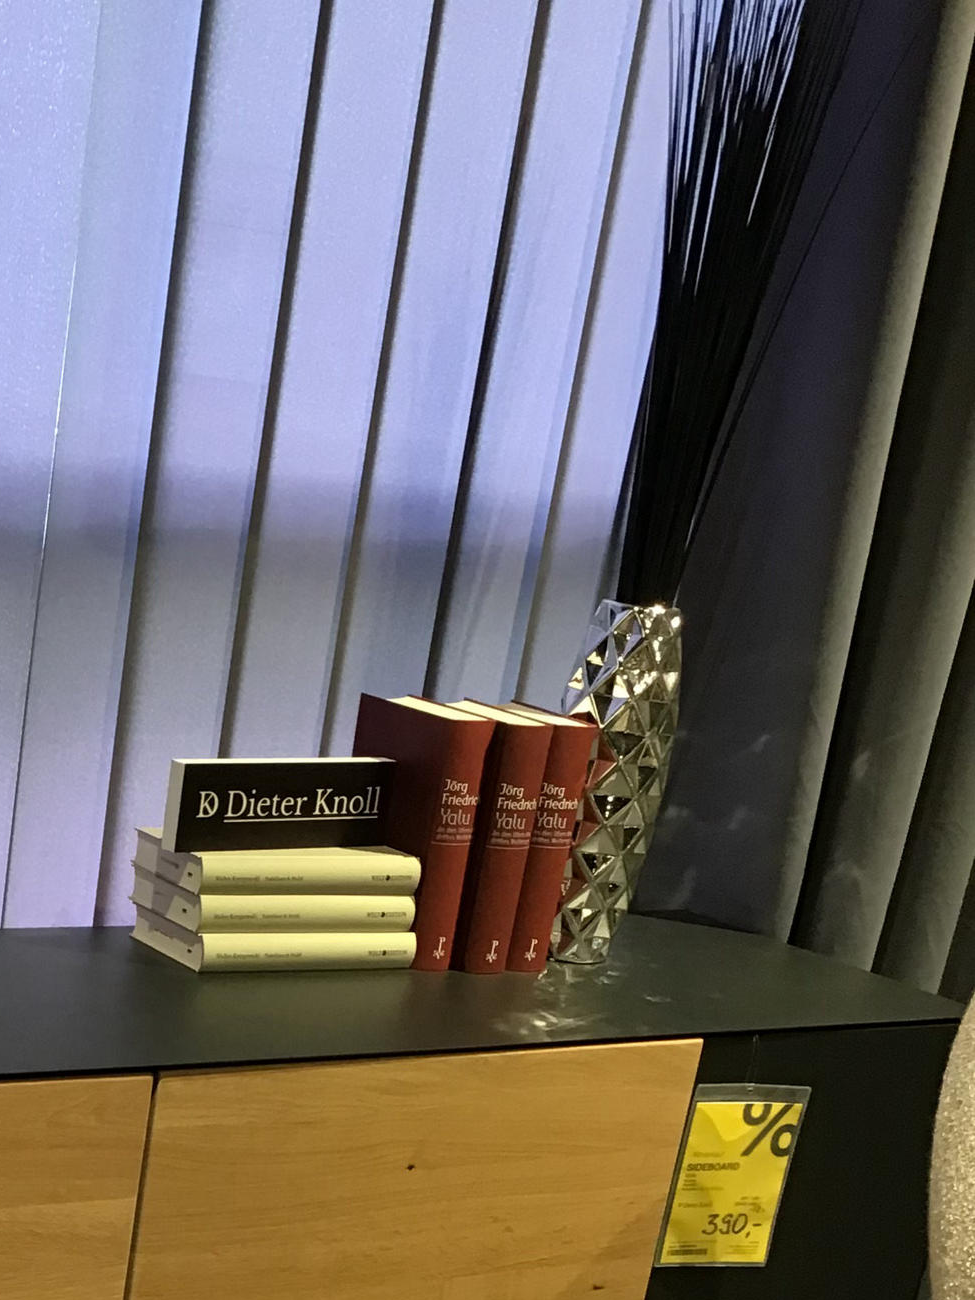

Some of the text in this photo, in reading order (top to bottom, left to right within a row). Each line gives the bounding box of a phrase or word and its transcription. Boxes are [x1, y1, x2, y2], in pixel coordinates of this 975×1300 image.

[443, 778, 468, 794] Jörg
[499, 783, 524, 799] Jörg
[541, 783, 566, 798] Jörg
[224, 789, 308, 818] Dieter
[313, 786, 381, 816] Knoll
[442, 793, 480, 806] Friedric
[497, 797, 537, 811] Friedrich
[440, 808, 471, 825] Yalu
[495, 812, 526, 830] Yalu
[536, 810, 567, 829] Yalu
[687, 1162, 740, 1171] SIDEBOARD
